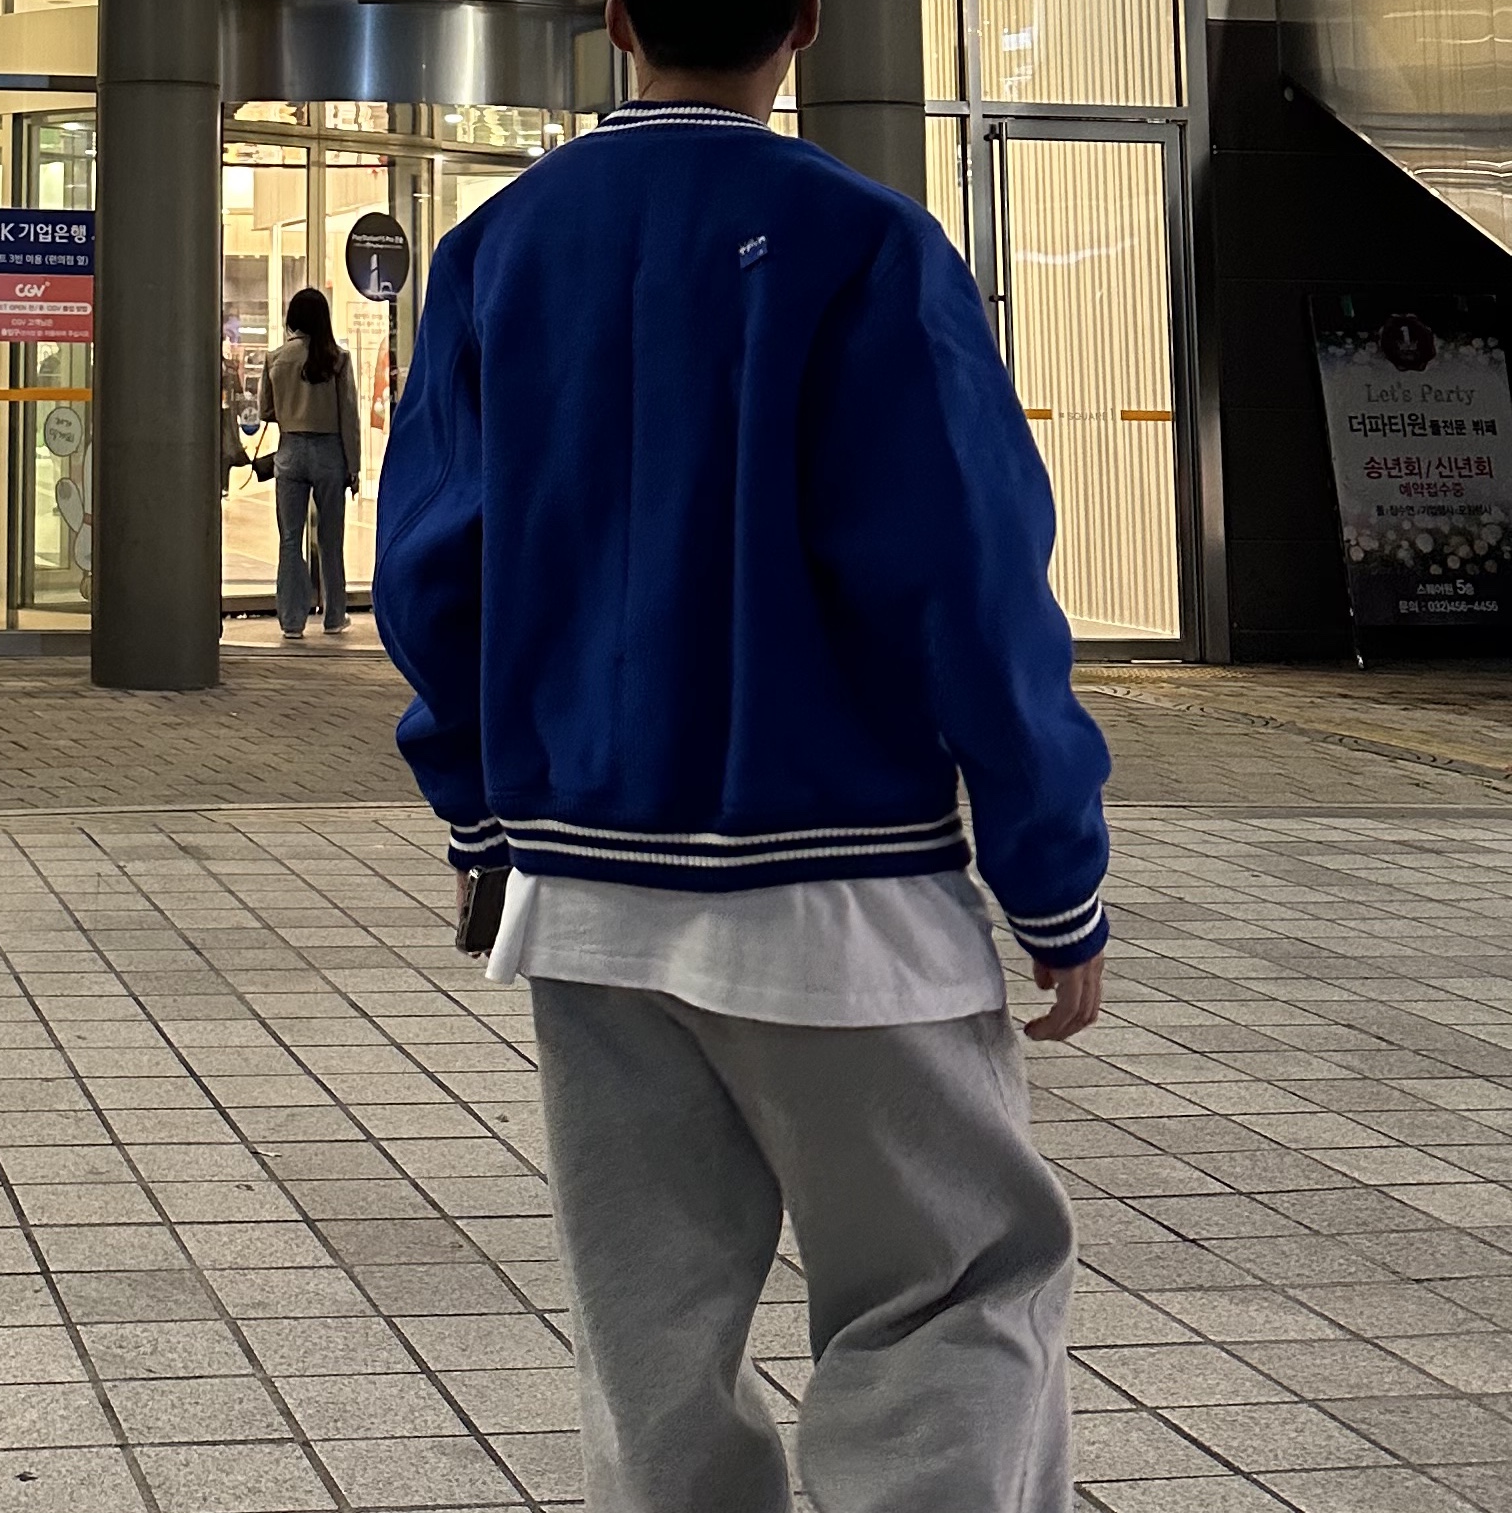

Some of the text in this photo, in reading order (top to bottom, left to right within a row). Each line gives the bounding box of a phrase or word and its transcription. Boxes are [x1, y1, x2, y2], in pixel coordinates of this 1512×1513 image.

[18, 223, 87, 244] 기업은행
[15, 282, 46, 298] CGV
[1365, 382, 1476, 406] Let's Party
[1348, 412, 1428, 437] 더파티원
[1399, 481, 1465, 498] 예약접수중
